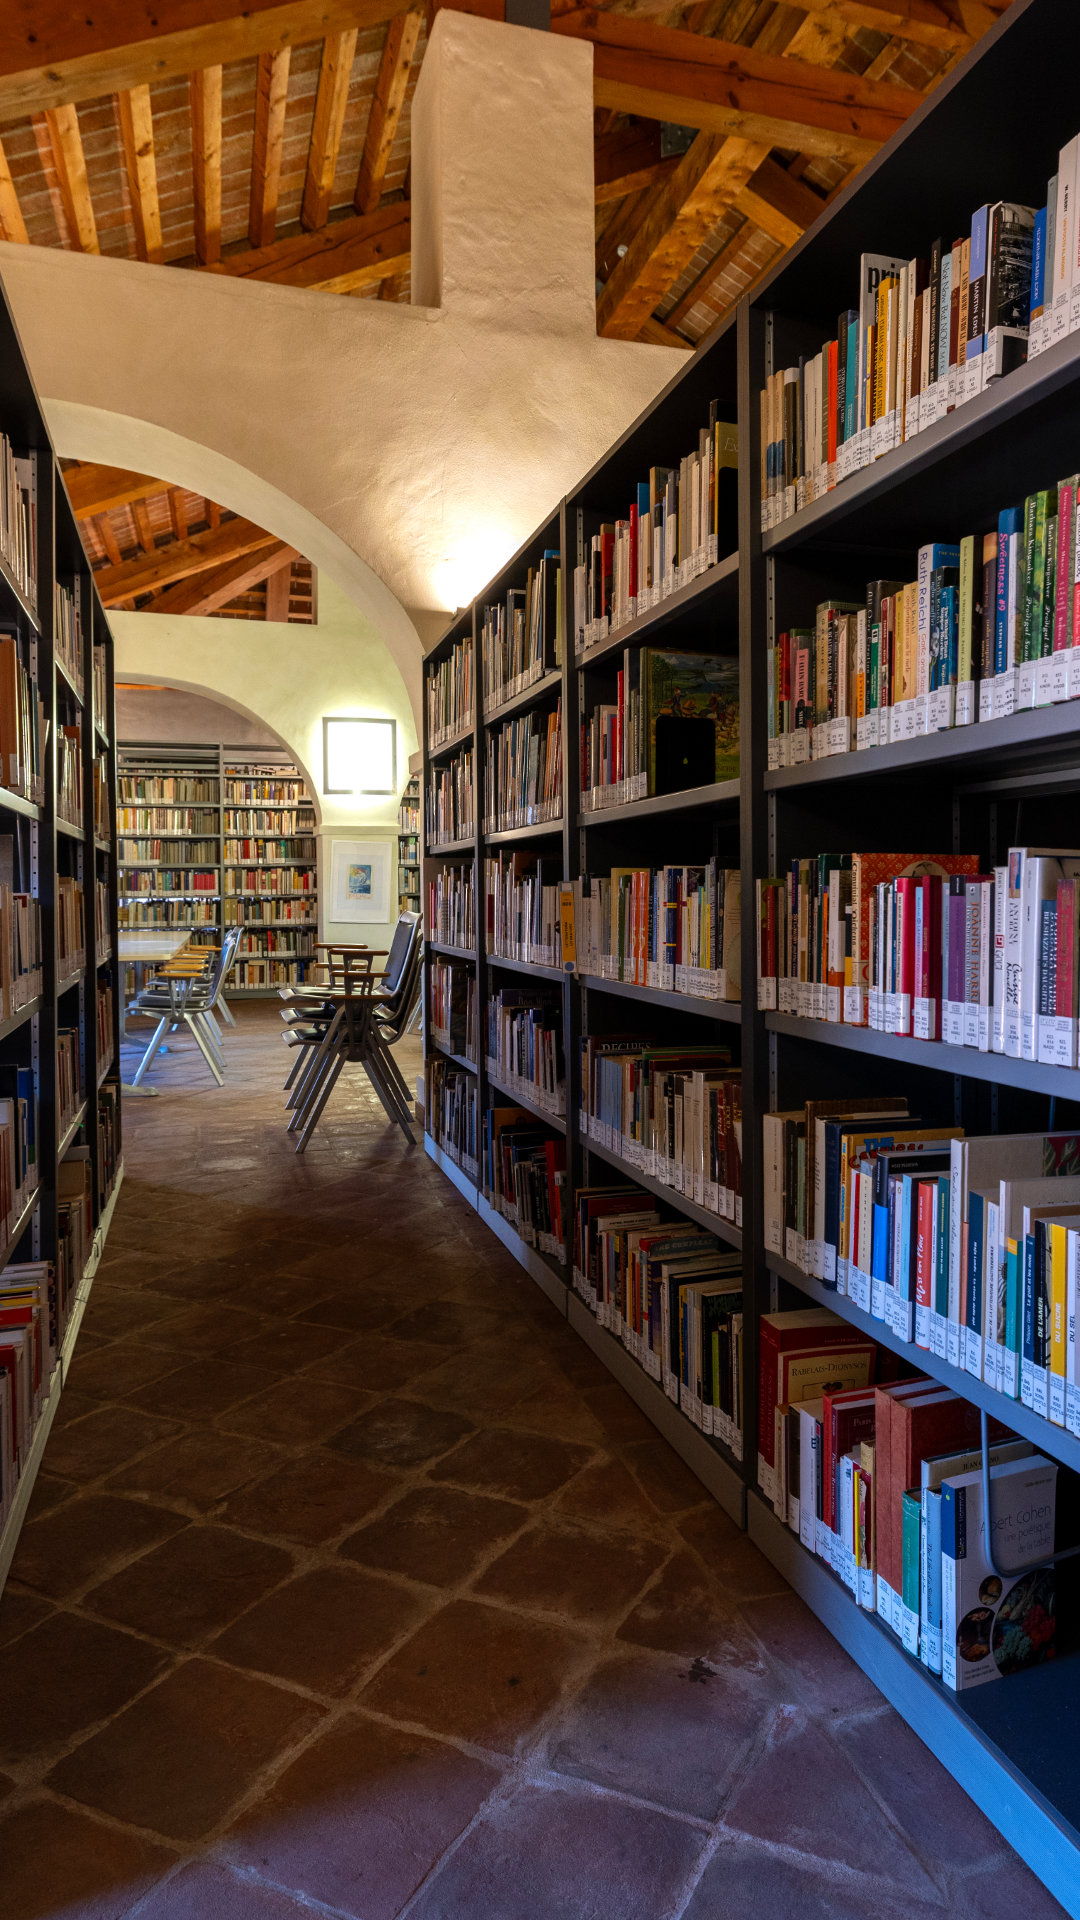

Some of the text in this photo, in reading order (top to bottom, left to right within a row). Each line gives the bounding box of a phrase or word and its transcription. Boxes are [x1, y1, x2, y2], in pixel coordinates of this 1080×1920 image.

[940, 305, 949, 320] But
[972, 281, 981, 314] MARTIN
[1027, 502, 1036, 537] Barbara
[997, 533, 1008, 611] Sweetness #9
[1026, 539, 1034, 585] Kingsolver
[918, 552, 929, 631] Ruth Reichl
[1023, 596, 1032, 636] Prodigal
[1042, 605, 1050, 640] Prodigal
[970, 902, 980, 955] JOANNE
[1042, 911, 1050, 967] BELSHAZZAR'S
[1048, 912, 1057, 1014] BARBARA NADEL
[1012, 963, 1023, 1006] Cuisine
[1026, 1299, 1032, 1307] Le
[1037, 1327, 1044, 1338] DE
[1055, 1331, 1061, 1343] DU
[1069, 1331, 1075, 1343] DU
[963, 1460, 978, 1471] JEAN
[1016, 1503, 1052, 1524] Cohen
